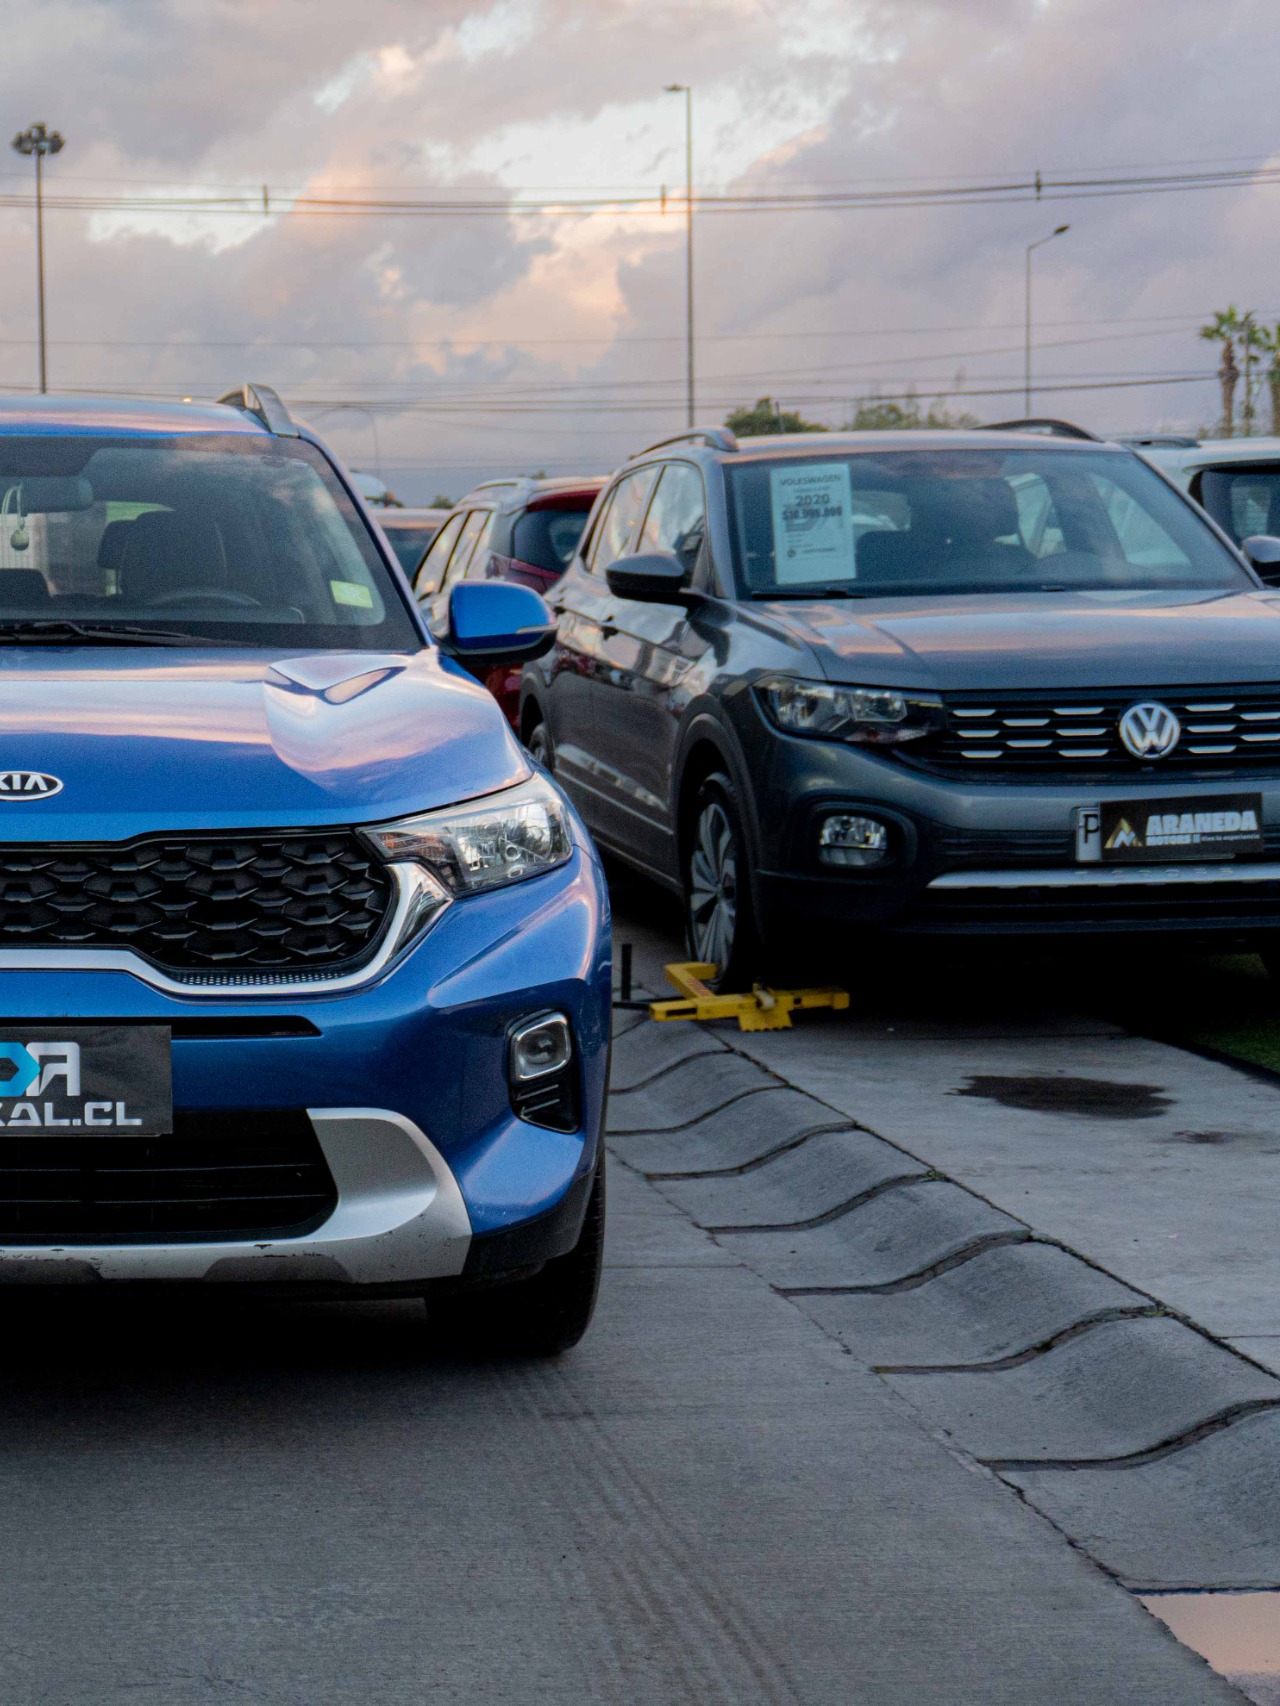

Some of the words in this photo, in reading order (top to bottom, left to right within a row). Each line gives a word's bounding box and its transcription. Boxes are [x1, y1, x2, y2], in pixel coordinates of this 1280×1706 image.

[780, 474, 842, 486] VOLKSWAGEN
[795, 493, 830, 506] 2020
[1145, 810, 1259, 835] ARANEDA
[1146, 834, 1191, 846] MOTORS
